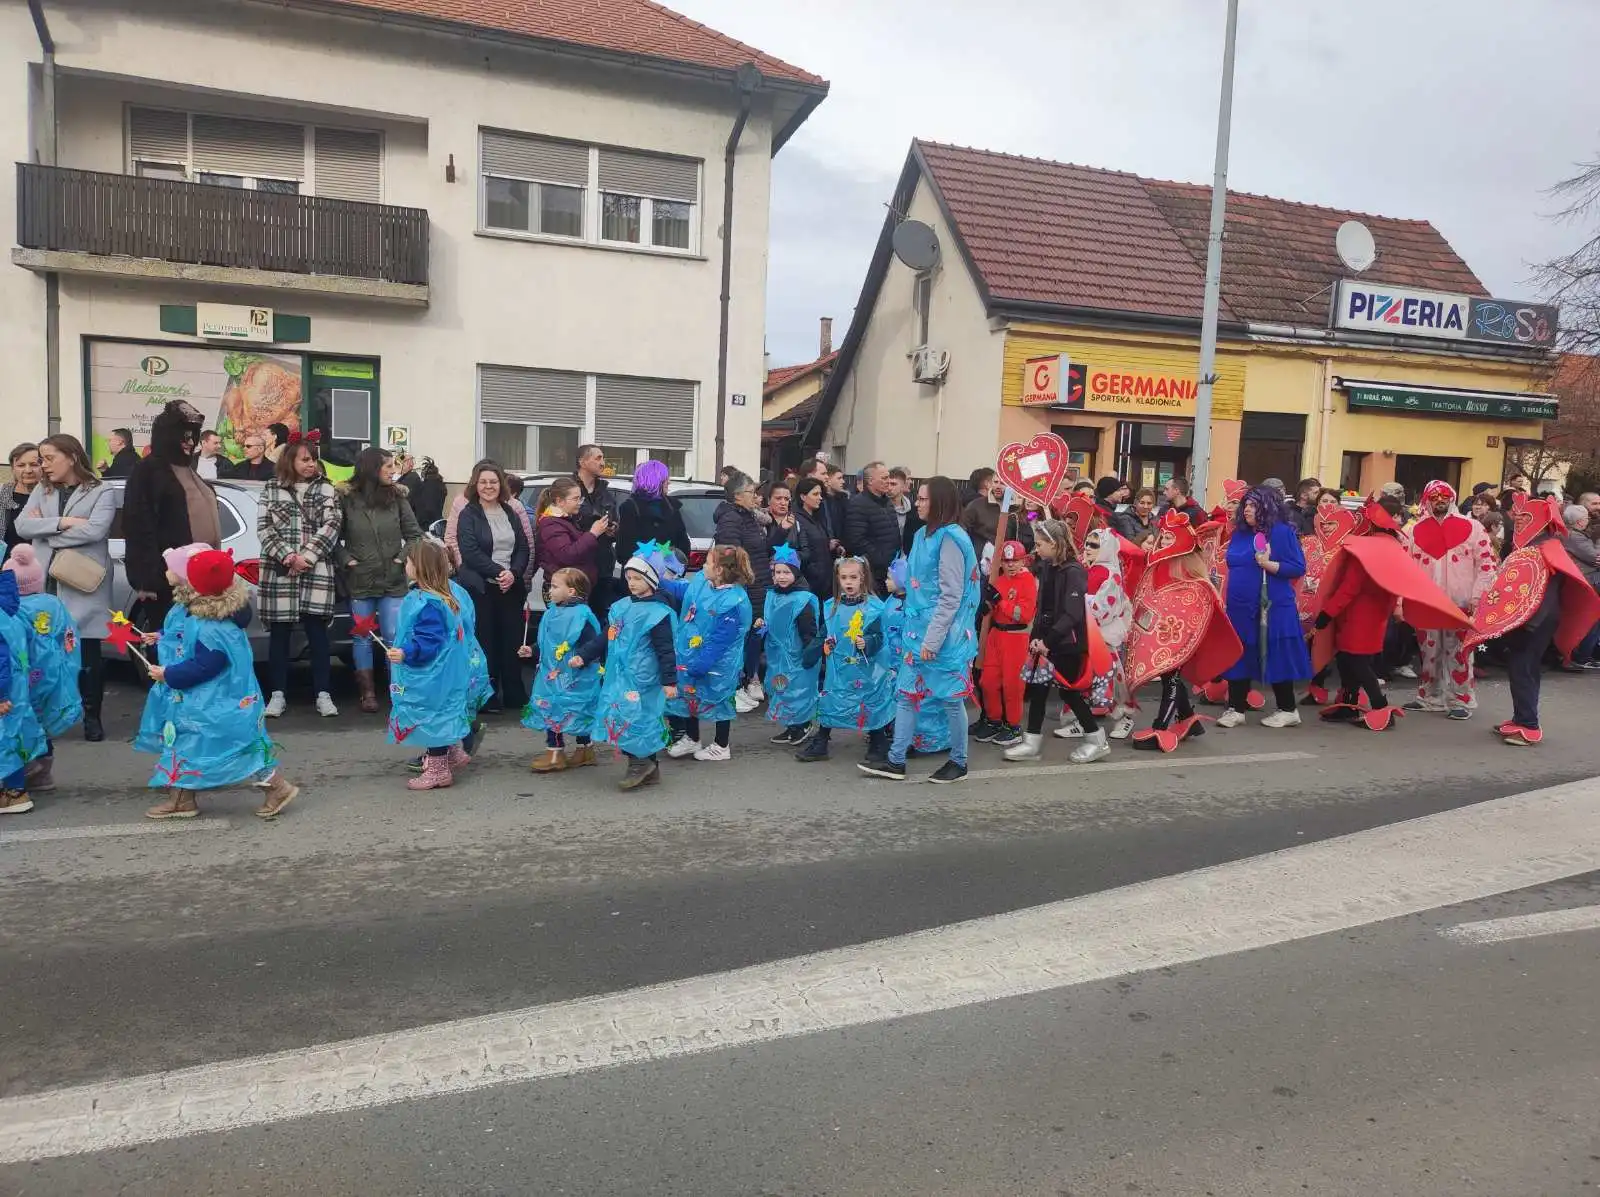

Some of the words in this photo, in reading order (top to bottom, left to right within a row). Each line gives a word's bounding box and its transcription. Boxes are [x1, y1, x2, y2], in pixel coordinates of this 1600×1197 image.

[1349, 291, 1463, 330] PIZZERIA
[734, 395, 744, 405] 39
[1024, 392, 1057, 403] GERMANIA
[1091, 393, 1131, 403] SPORTSKA
[1136, 397, 1182, 407] KLADIONICA
[1431, 401, 1462, 411] TRATTORIA
